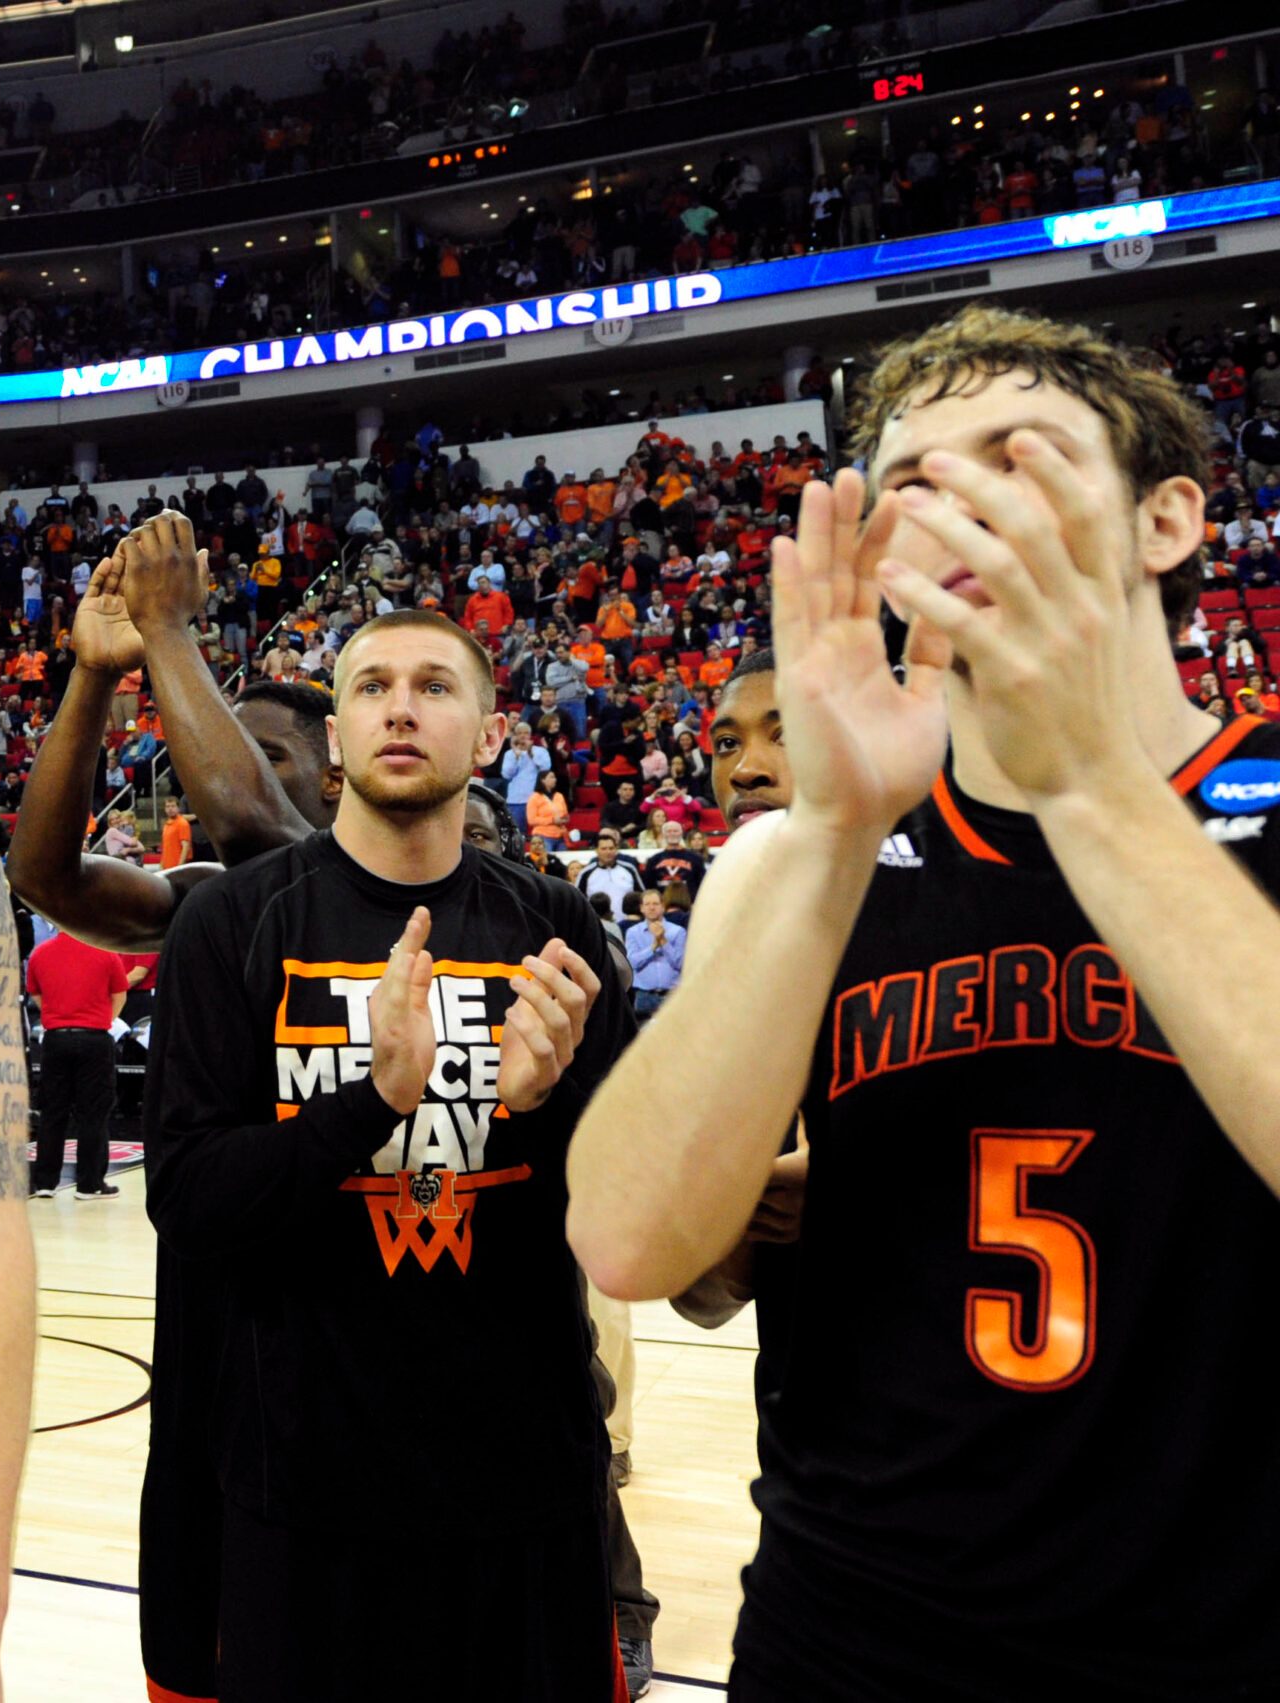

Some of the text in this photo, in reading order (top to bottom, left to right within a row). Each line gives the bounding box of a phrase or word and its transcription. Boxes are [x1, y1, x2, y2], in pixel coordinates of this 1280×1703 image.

[873, 72, 923, 101] 8:24
[1113, 240, 1143, 258] 118
[601, 319, 624, 335] 117
[60, 355, 168, 397] NCAA
[163, 383, 184, 398] 116
[1211, 781, 1280, 800] NCA
[964, 1128, 1097, 1392] 5
